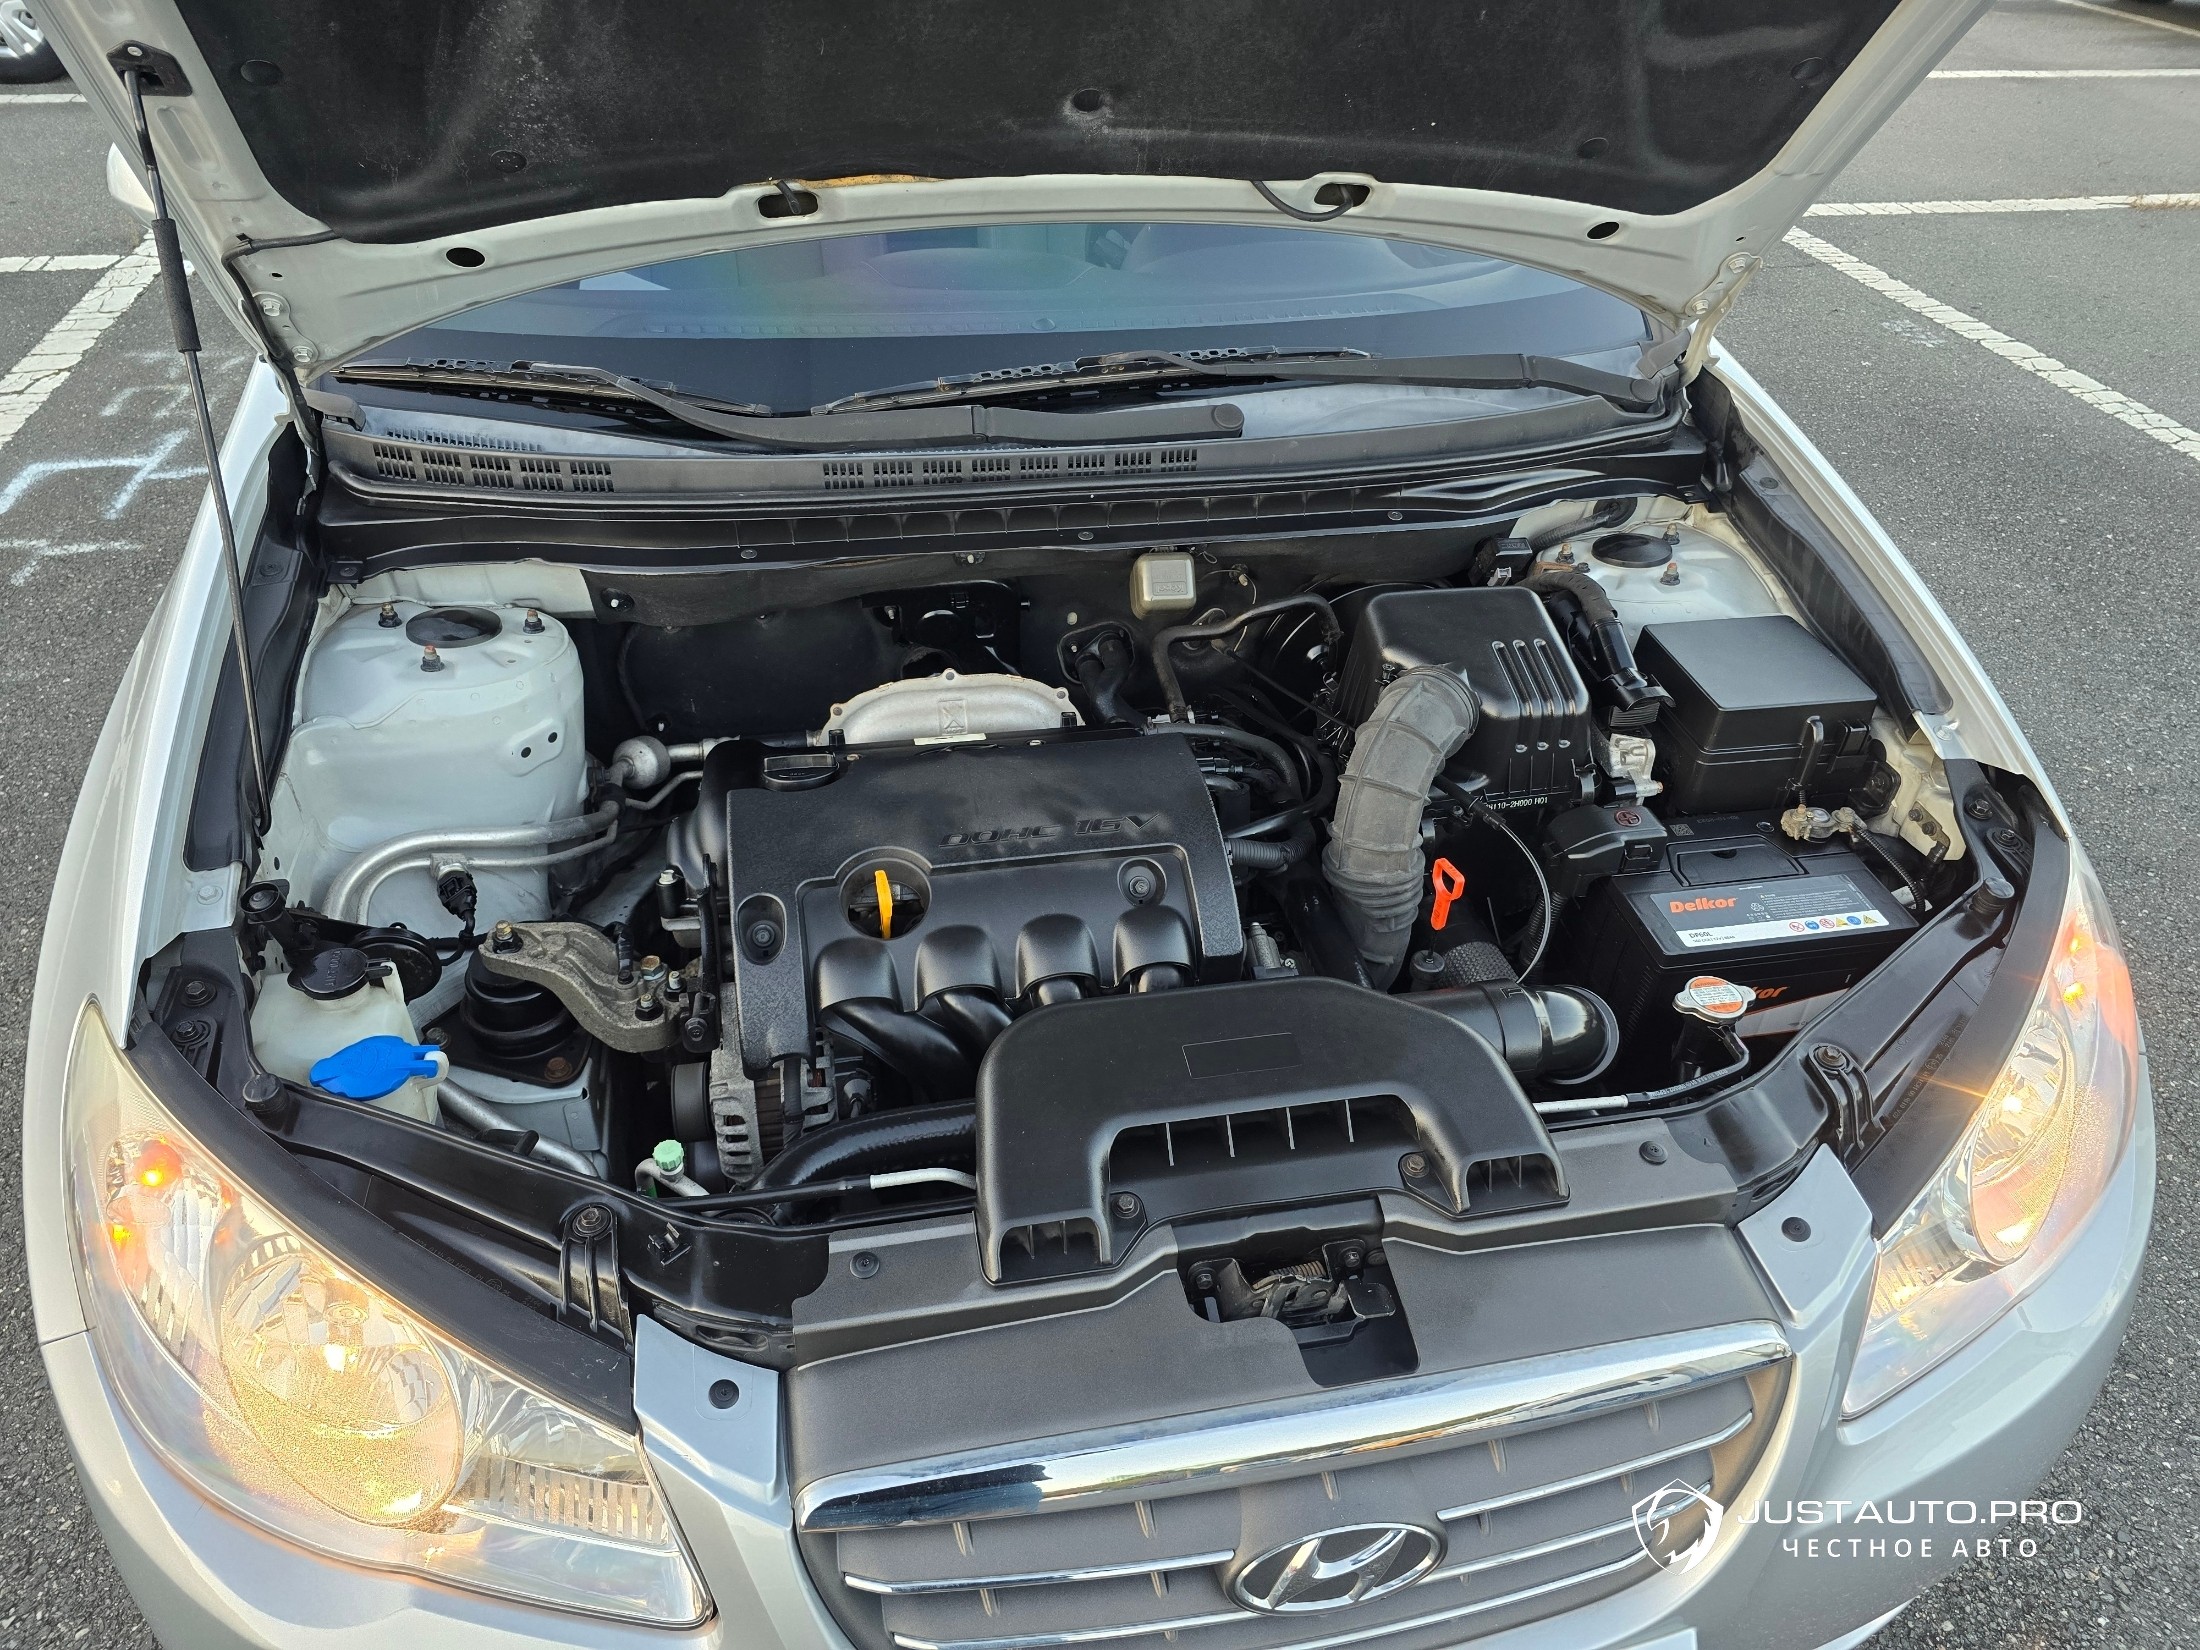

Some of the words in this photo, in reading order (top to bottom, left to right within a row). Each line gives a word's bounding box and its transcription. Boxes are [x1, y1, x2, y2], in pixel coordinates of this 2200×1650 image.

[939, 825, 1061, 848] DOHC
[1075, 813, 1160, 835] 16V
[1669, 897, 1737, 913] Delkor
